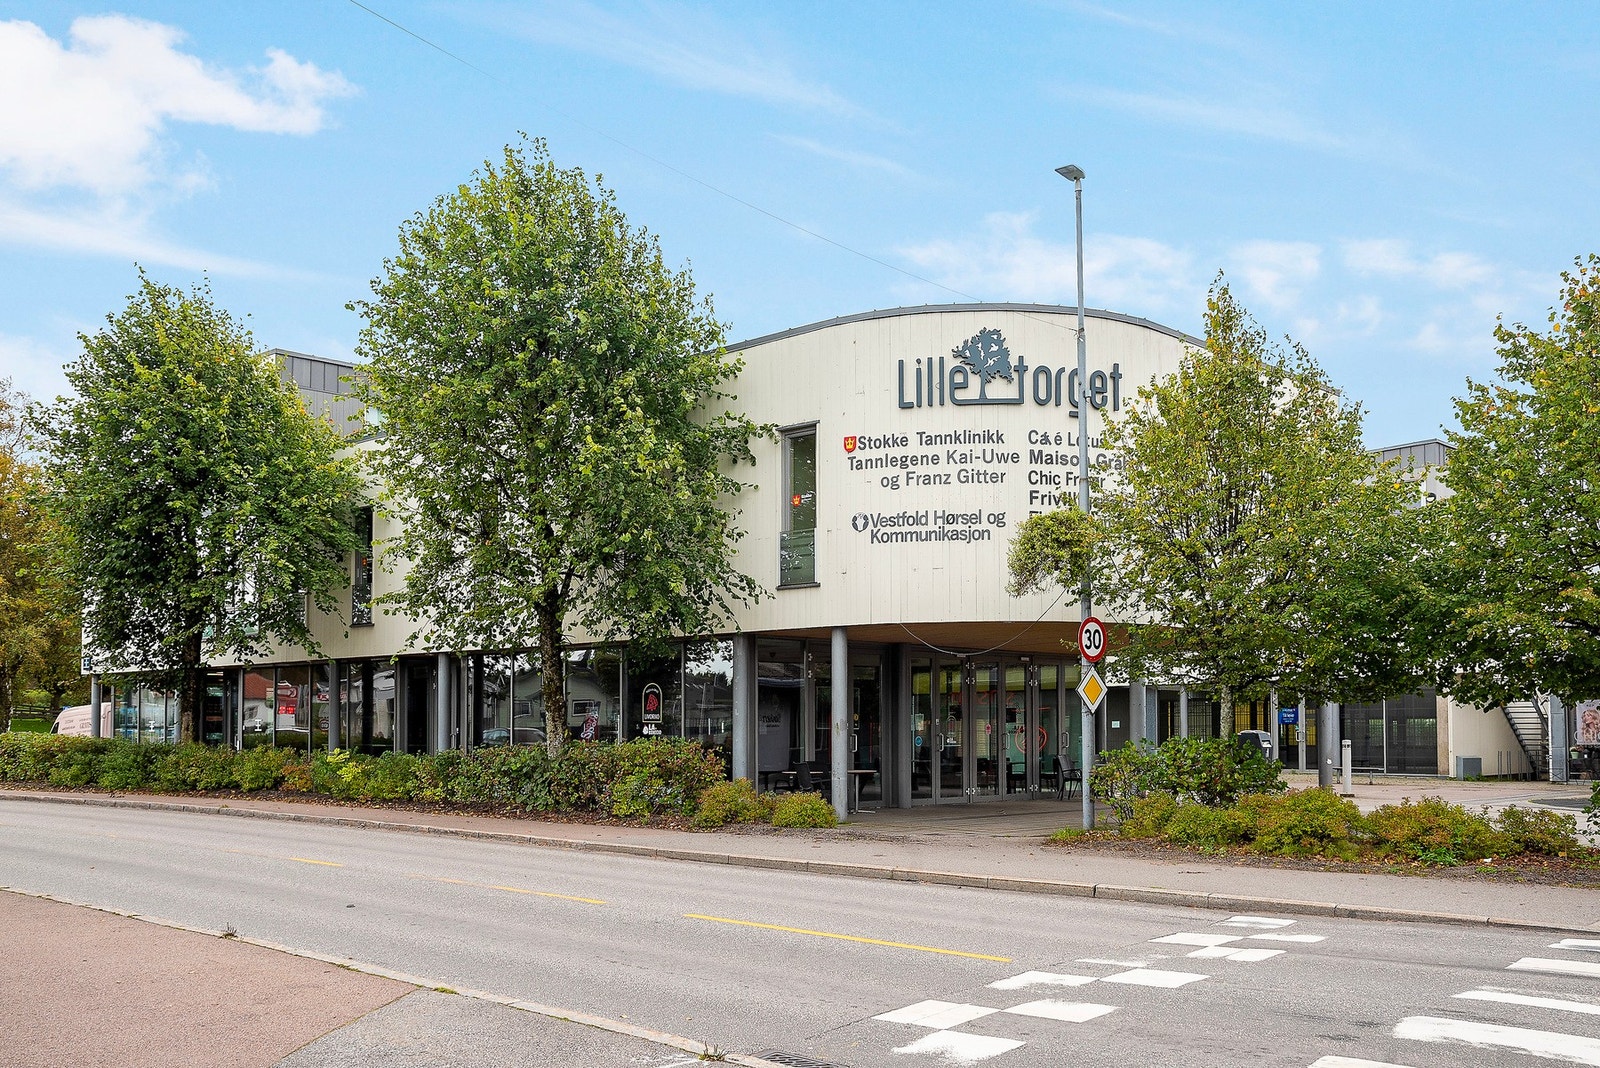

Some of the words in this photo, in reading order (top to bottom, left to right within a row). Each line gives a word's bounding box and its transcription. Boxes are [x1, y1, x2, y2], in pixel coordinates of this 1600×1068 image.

[898, 356, 968, 409] Lille
[858, 434, 909, 451] Stokke
[916, 429, 1006, 447] Tannklinikk
[847, 453, 941, 471] Tannlegene
[946, 448, 1021, 466] Kai-Uwe
[1029, 449, 1090, 467] Maiso
[880, 475, 901, 491] og
[905, 470, 952, 487] Franz
[957, 468, 1007, 485] Gitter
[1028, 470, 1061, 486] Chic
[870, 510, 929, 529] Vestfold
[933, 509, 982, 526] Hørsel
[986, 511, 1007, 528] og
[870, 525, 992, 545] Kommunikasjon
[1084, 628, 1102, 650] 30
